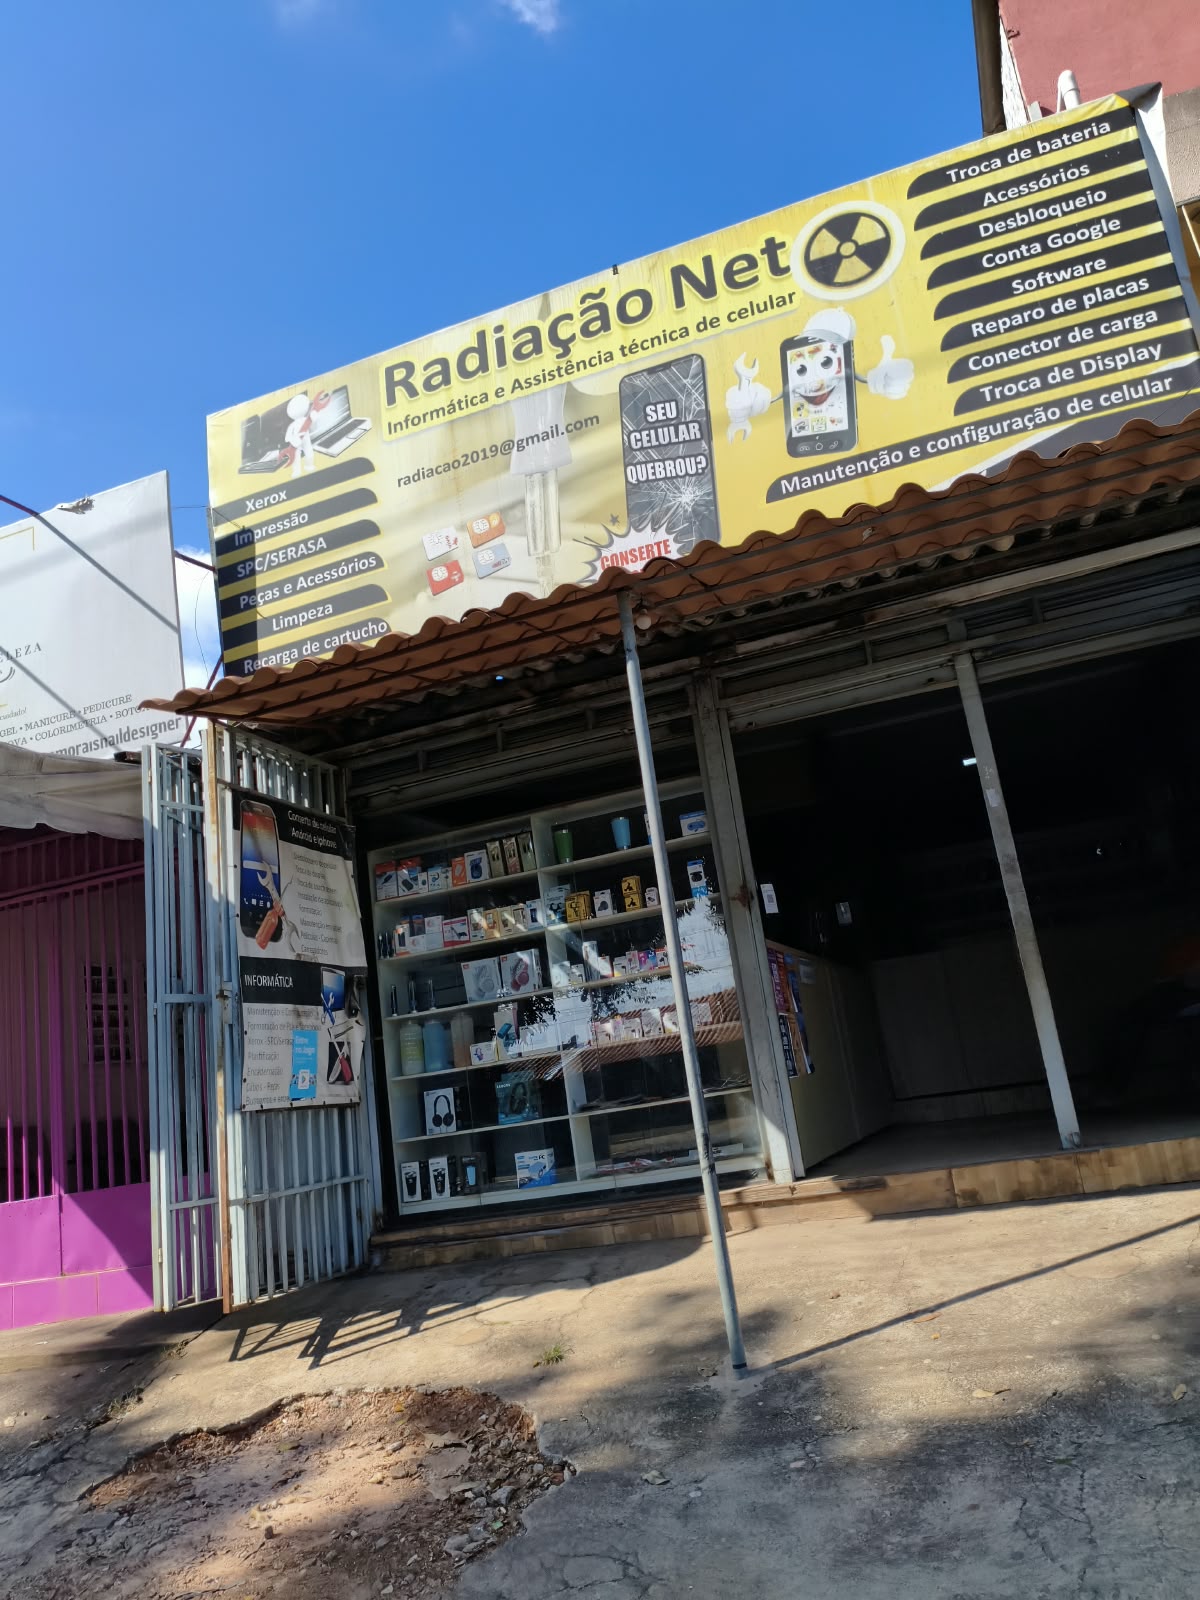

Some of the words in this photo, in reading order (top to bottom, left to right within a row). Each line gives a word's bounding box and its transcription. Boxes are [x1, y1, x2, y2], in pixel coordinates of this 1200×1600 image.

[946, 157, 1002, 184] Troca
[1006, 144, 1032, 165] de
[1037, 120, 1111, 155] bateria
[982, 163, 1090, 208] Acessórios
[978, 188, 1108, 239] Desbloqueio
[981, 240, 1042, 269] Conta
[1047, 216, 1121, 251] Google
[1011, 256, 1107, 295] Software
[385, 288, 653, 406] Radiação
[668, 236, 792, 310] Net
[971, 305, 1045, 339] Reparo
[1051, 297, 1077, 317] de
[1083, 276, 1150, 312] placas
[386, 390, 489, 436] Informática
[495, 386, 506, 400] e
[510, 350, 615, 395] Assistência
[619, 324, 690, 359] técnica
[695, 316, 721, 334] de
[726, 290, 796, 324] celular
[968, 335, 1062, 372] Conector
[1070, 323, 1094, 343] de
[1100, 309, 1158, 338] carga
[979, 376, 1042, 404] Troca
[1047, 365, 1075, 386] de
[1081, 341, 1163, 378] Display
[645, 401, 678, 423] SEU
[396, 413, 600, 488] radiacao2019@gmail.com
[629, 421, 702, 450] CELULAR
[779, 447, 904, 496] Manutenção
[908, 446, 922, 459] e
[927, 405, 1060, 453] configuração
[1066, 395, 1094, 415] de
[1099, 375, 1173, 409] celular
[626, 454, 707, 485] QUEBROU?
[245, 489, 288, 514] Xerox
[234, 510, 309, 547] Impressão
[236, 536, 328, 578] SPC/SERASA
[600, 539, 671, 572] CONSERTE
[239, 584, 280, 610] Peças
[284, 582, 294, 595] e
[296, 553, 377, 591] Acessórios
[272, 602, 334, 632] Limpeza
[243, 645, 299, 675] Recarga
[302, 635, 321, 656] de
[323, 619, 388, 649] cartucho
[24, 709, 76, 731] MANICURE
[83, 694, 132, 715] PEDICURE
[35, 715, 107, 742] COLORIMETRIA
[244, 973, 294, 988] INFORMÁTICA
